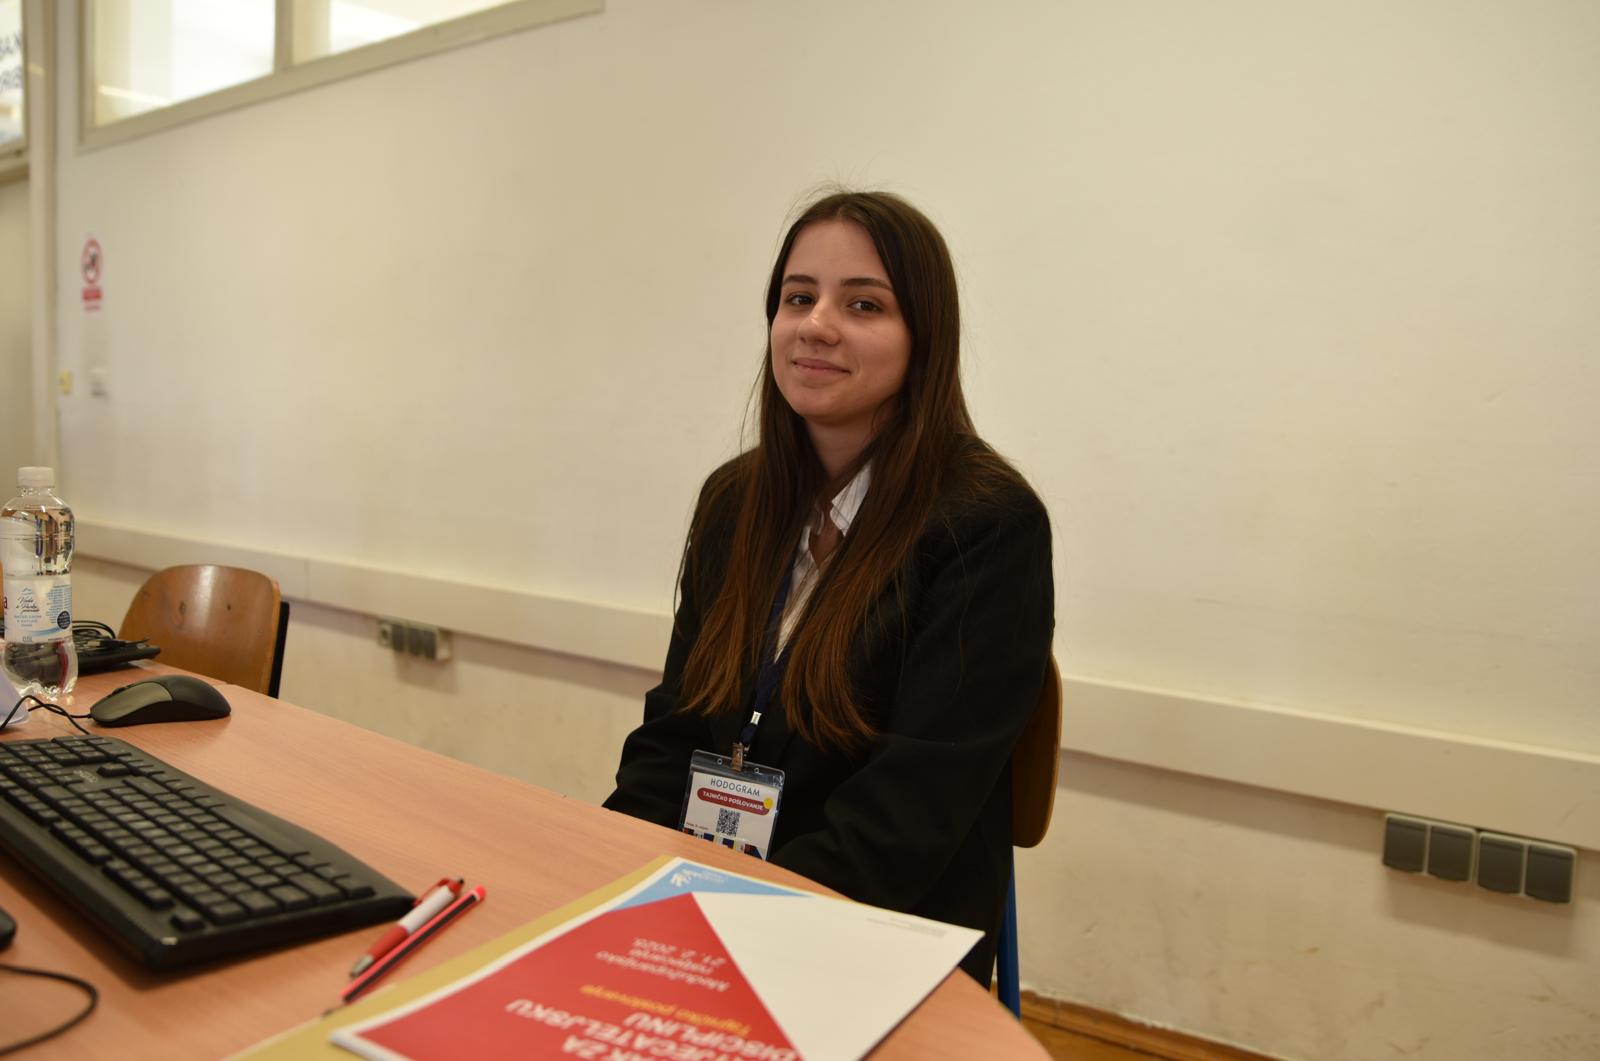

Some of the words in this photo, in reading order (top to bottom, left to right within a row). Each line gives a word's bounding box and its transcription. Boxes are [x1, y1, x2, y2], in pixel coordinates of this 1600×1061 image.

[710, 778, 760, 797] HODOGRAM
[728, 797, 763, 810] POSLOVANJE
[562, 1034, 609, 1060] ZA
[622, 1011, 797, 1061] DISCIPLINU
